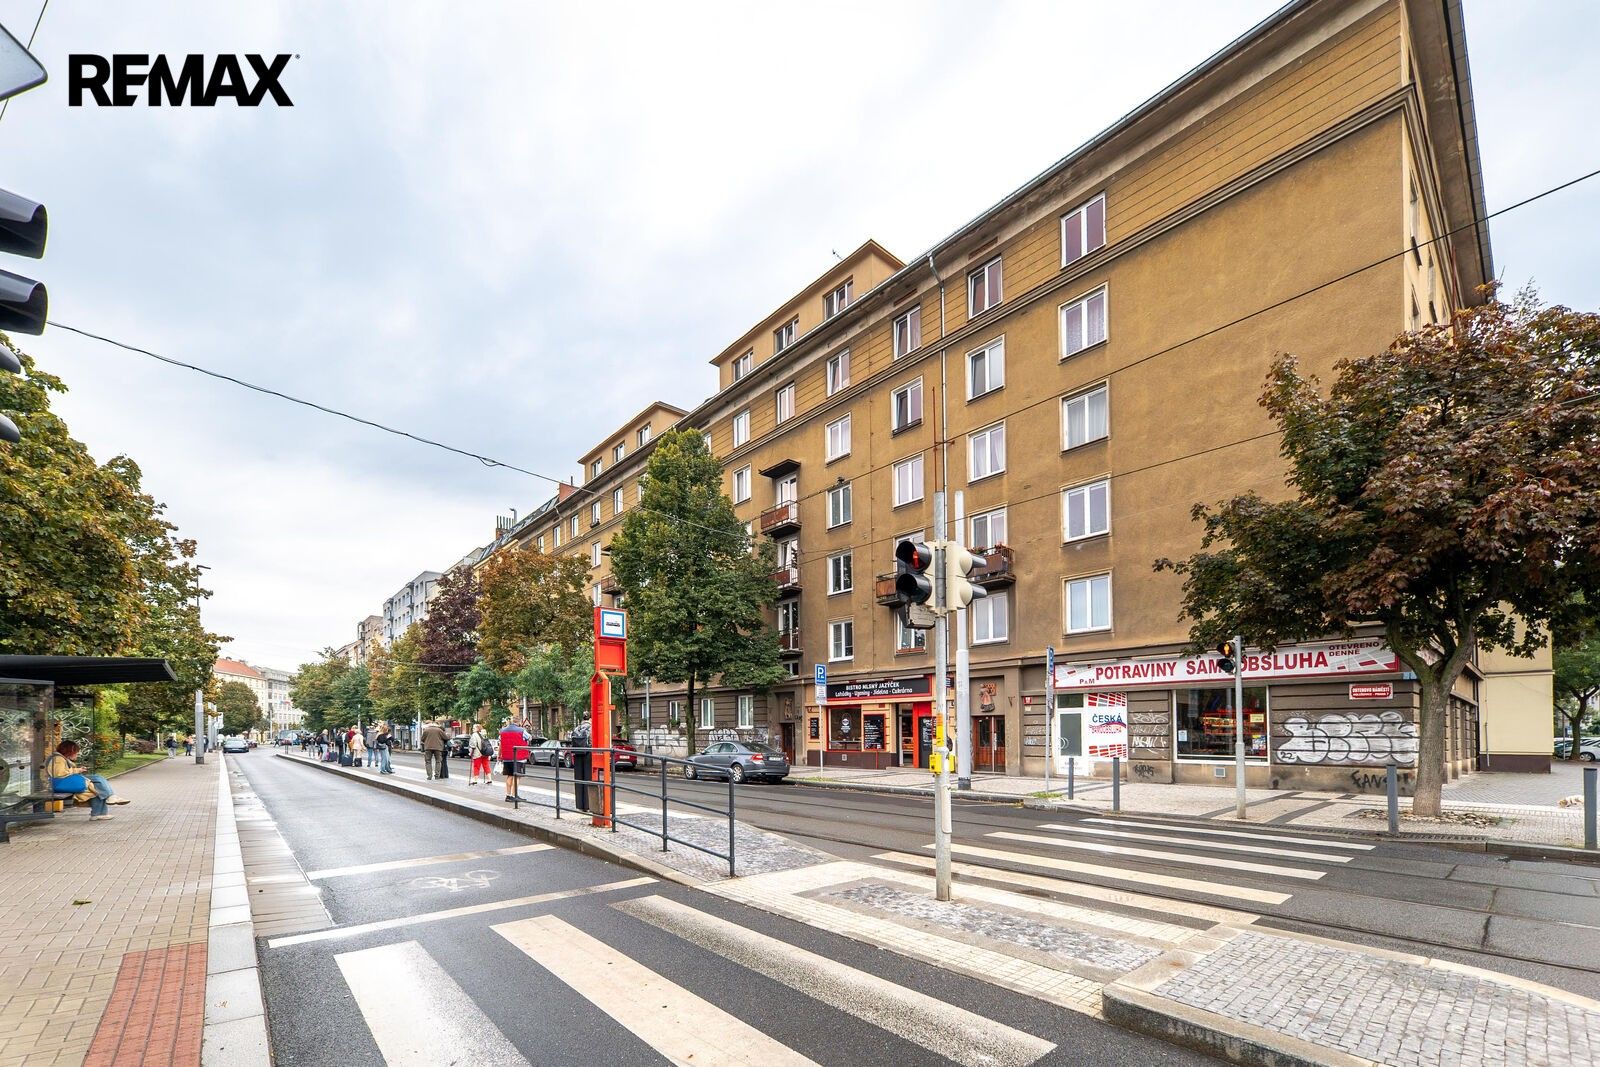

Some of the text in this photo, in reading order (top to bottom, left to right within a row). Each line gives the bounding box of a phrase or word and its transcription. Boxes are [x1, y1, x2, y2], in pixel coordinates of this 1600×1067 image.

[1095, 661, 1177, 681] POTRAVINY
[1186, 651, 1329, 675] SAMBSLUHA
[1091, 712, 1123, 723] ČESKÁ
